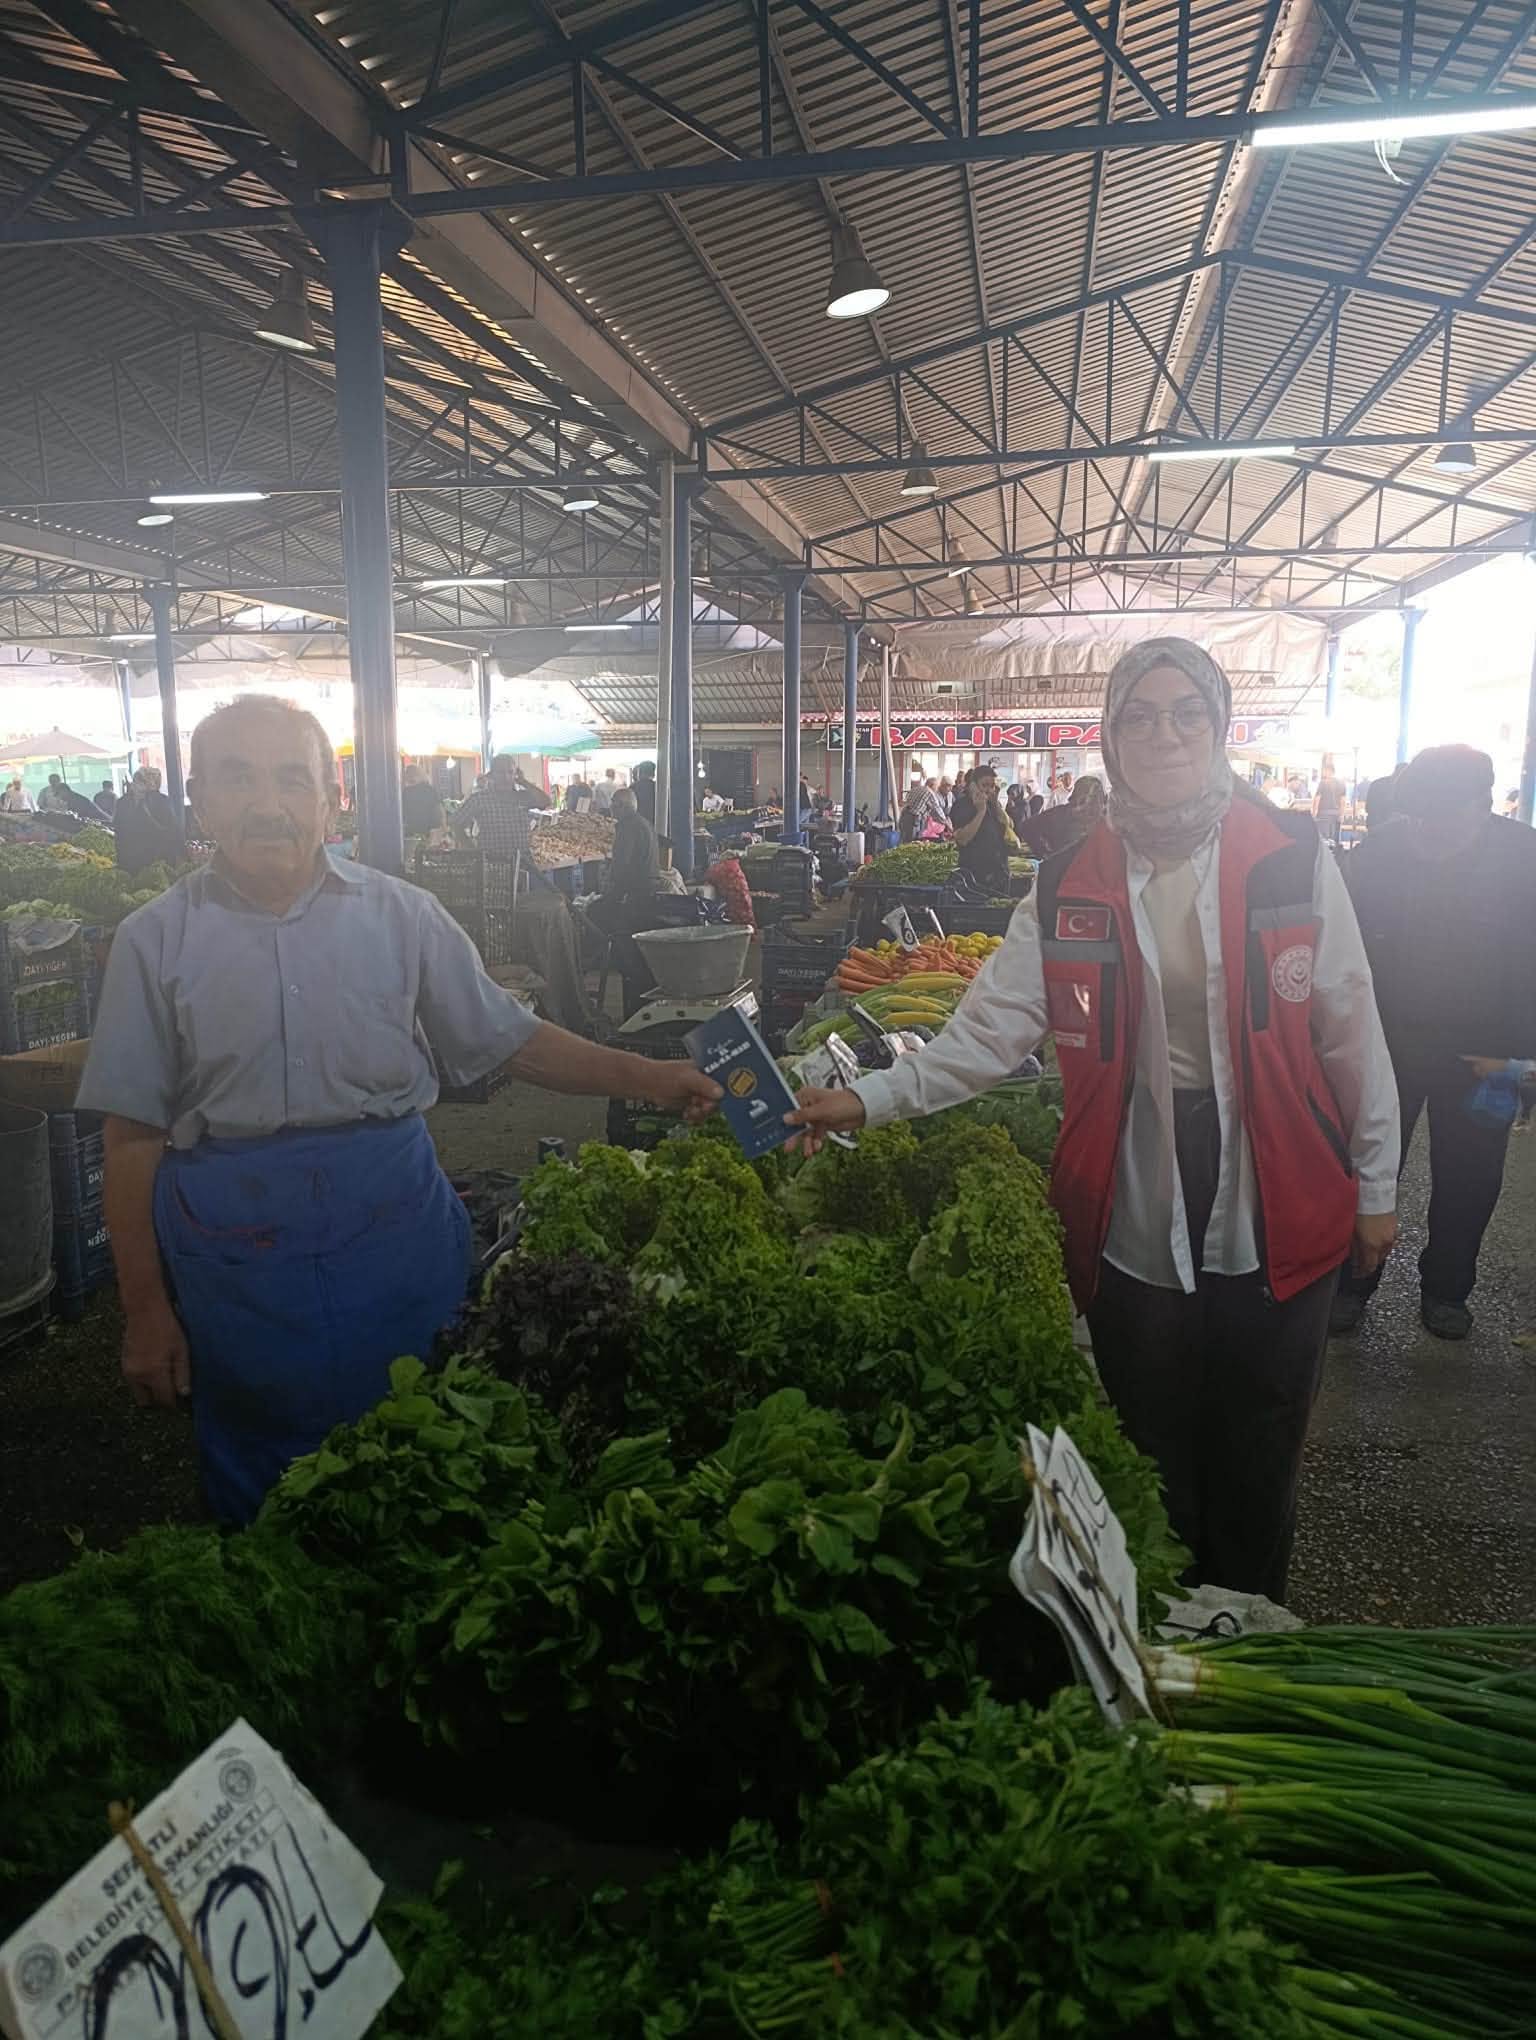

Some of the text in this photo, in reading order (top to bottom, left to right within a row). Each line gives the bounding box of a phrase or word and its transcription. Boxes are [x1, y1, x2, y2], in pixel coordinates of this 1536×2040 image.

[871, 722, 1248, 747] BALIK PAI
[102, 1818, 178, 1899] ŞEFATLİ
[65, 1885, 146, 1968] BELEDİYE
